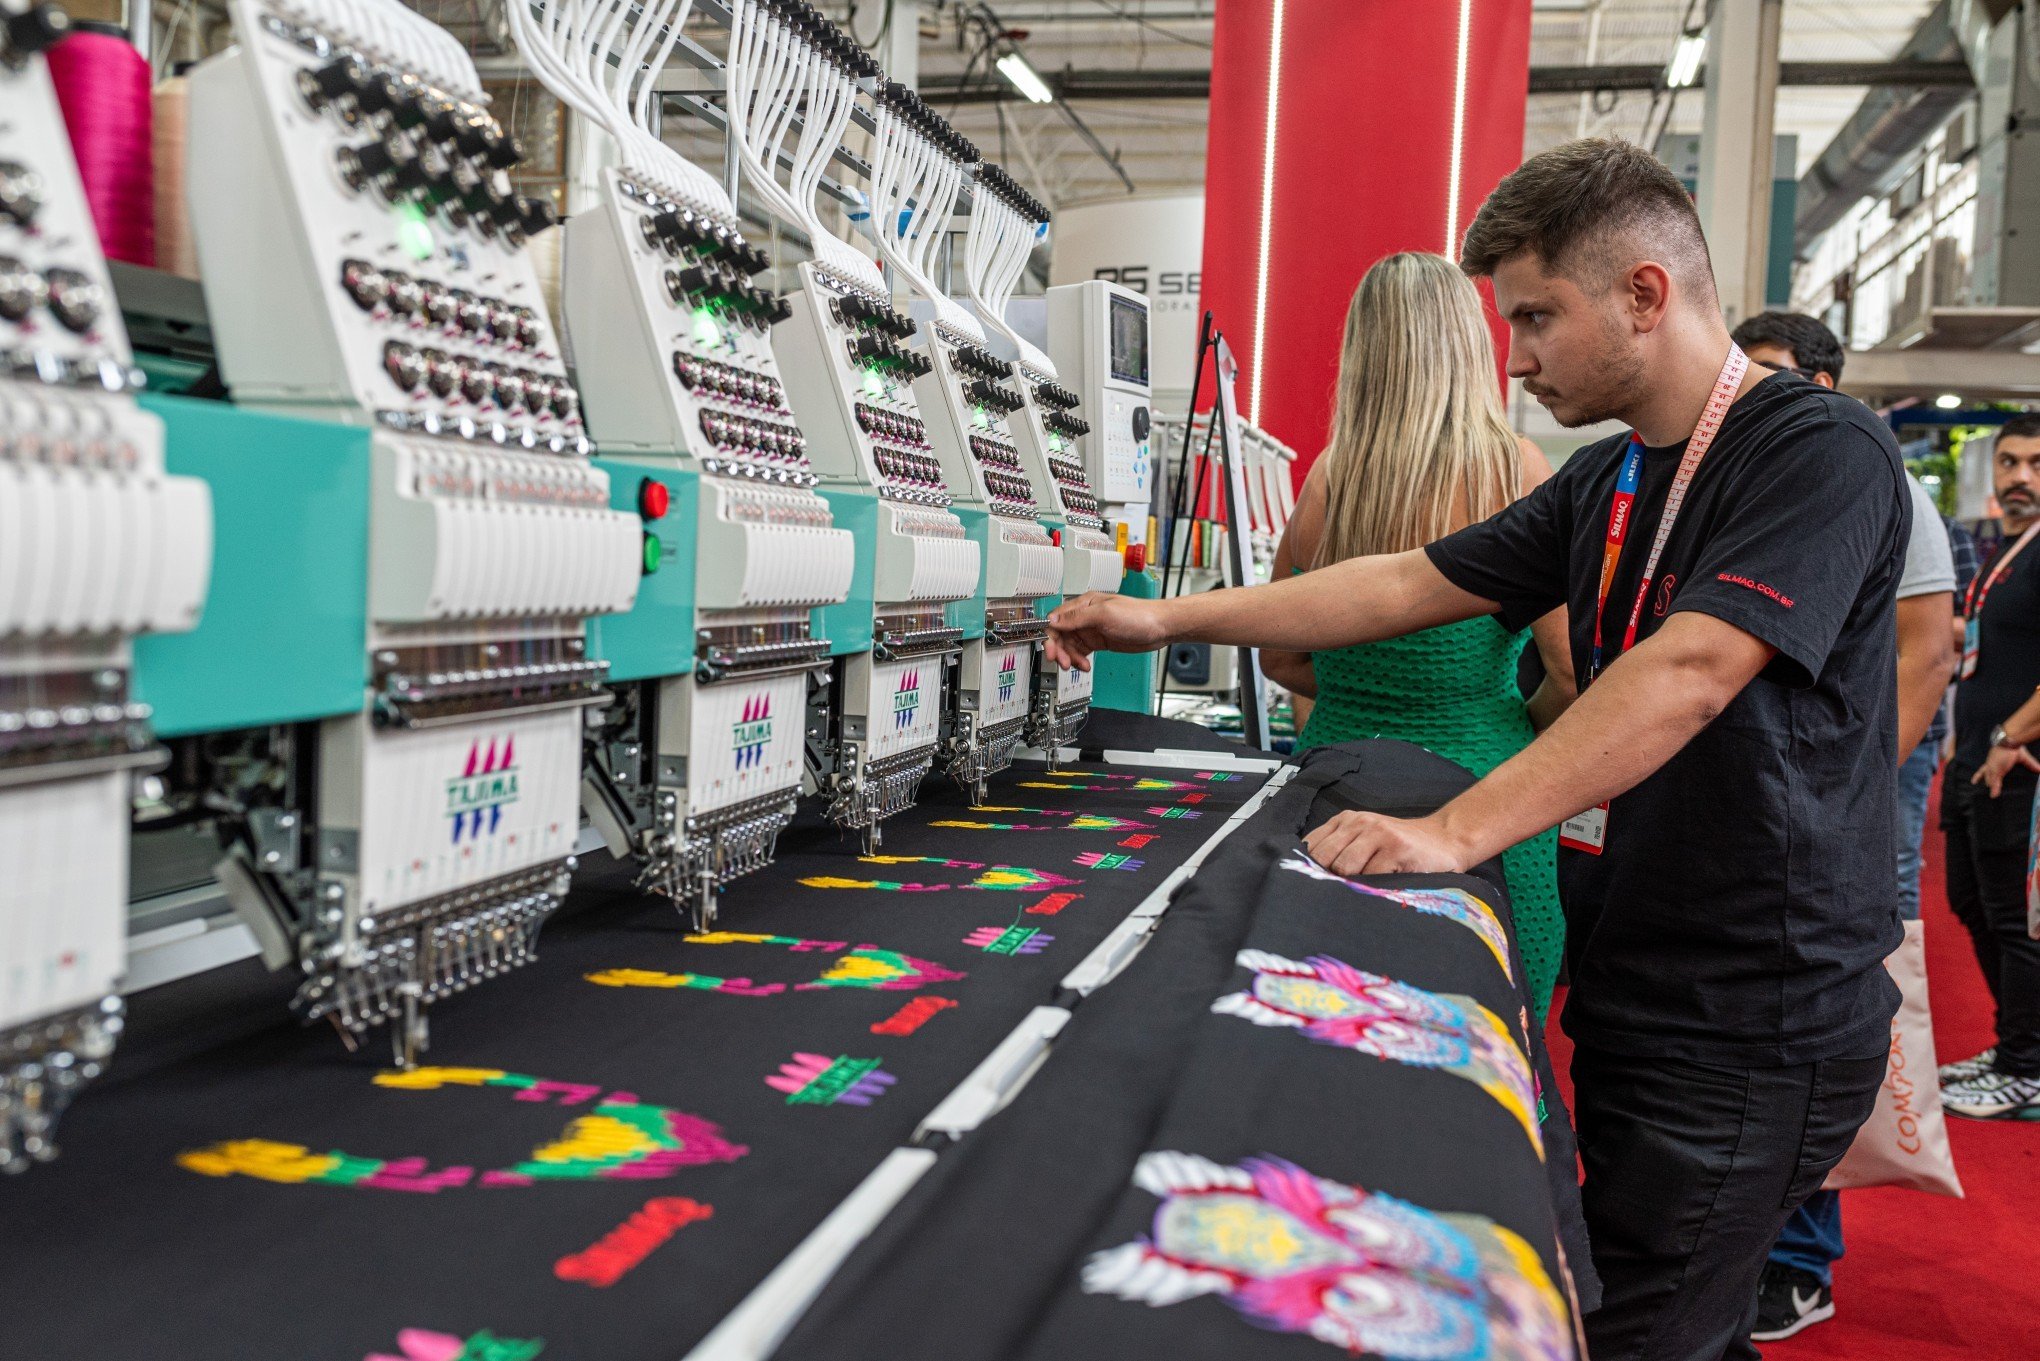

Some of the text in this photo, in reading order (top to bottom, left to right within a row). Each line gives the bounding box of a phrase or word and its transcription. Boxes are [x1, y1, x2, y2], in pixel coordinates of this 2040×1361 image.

[1628, 454, 1640, 481] JUKI
[1718, 573, 1794, 607] SILMAQ.COM.BR
[894, 691, 918, 709] TAJIMA
[734, 722, 771, 746] TAJIMA
